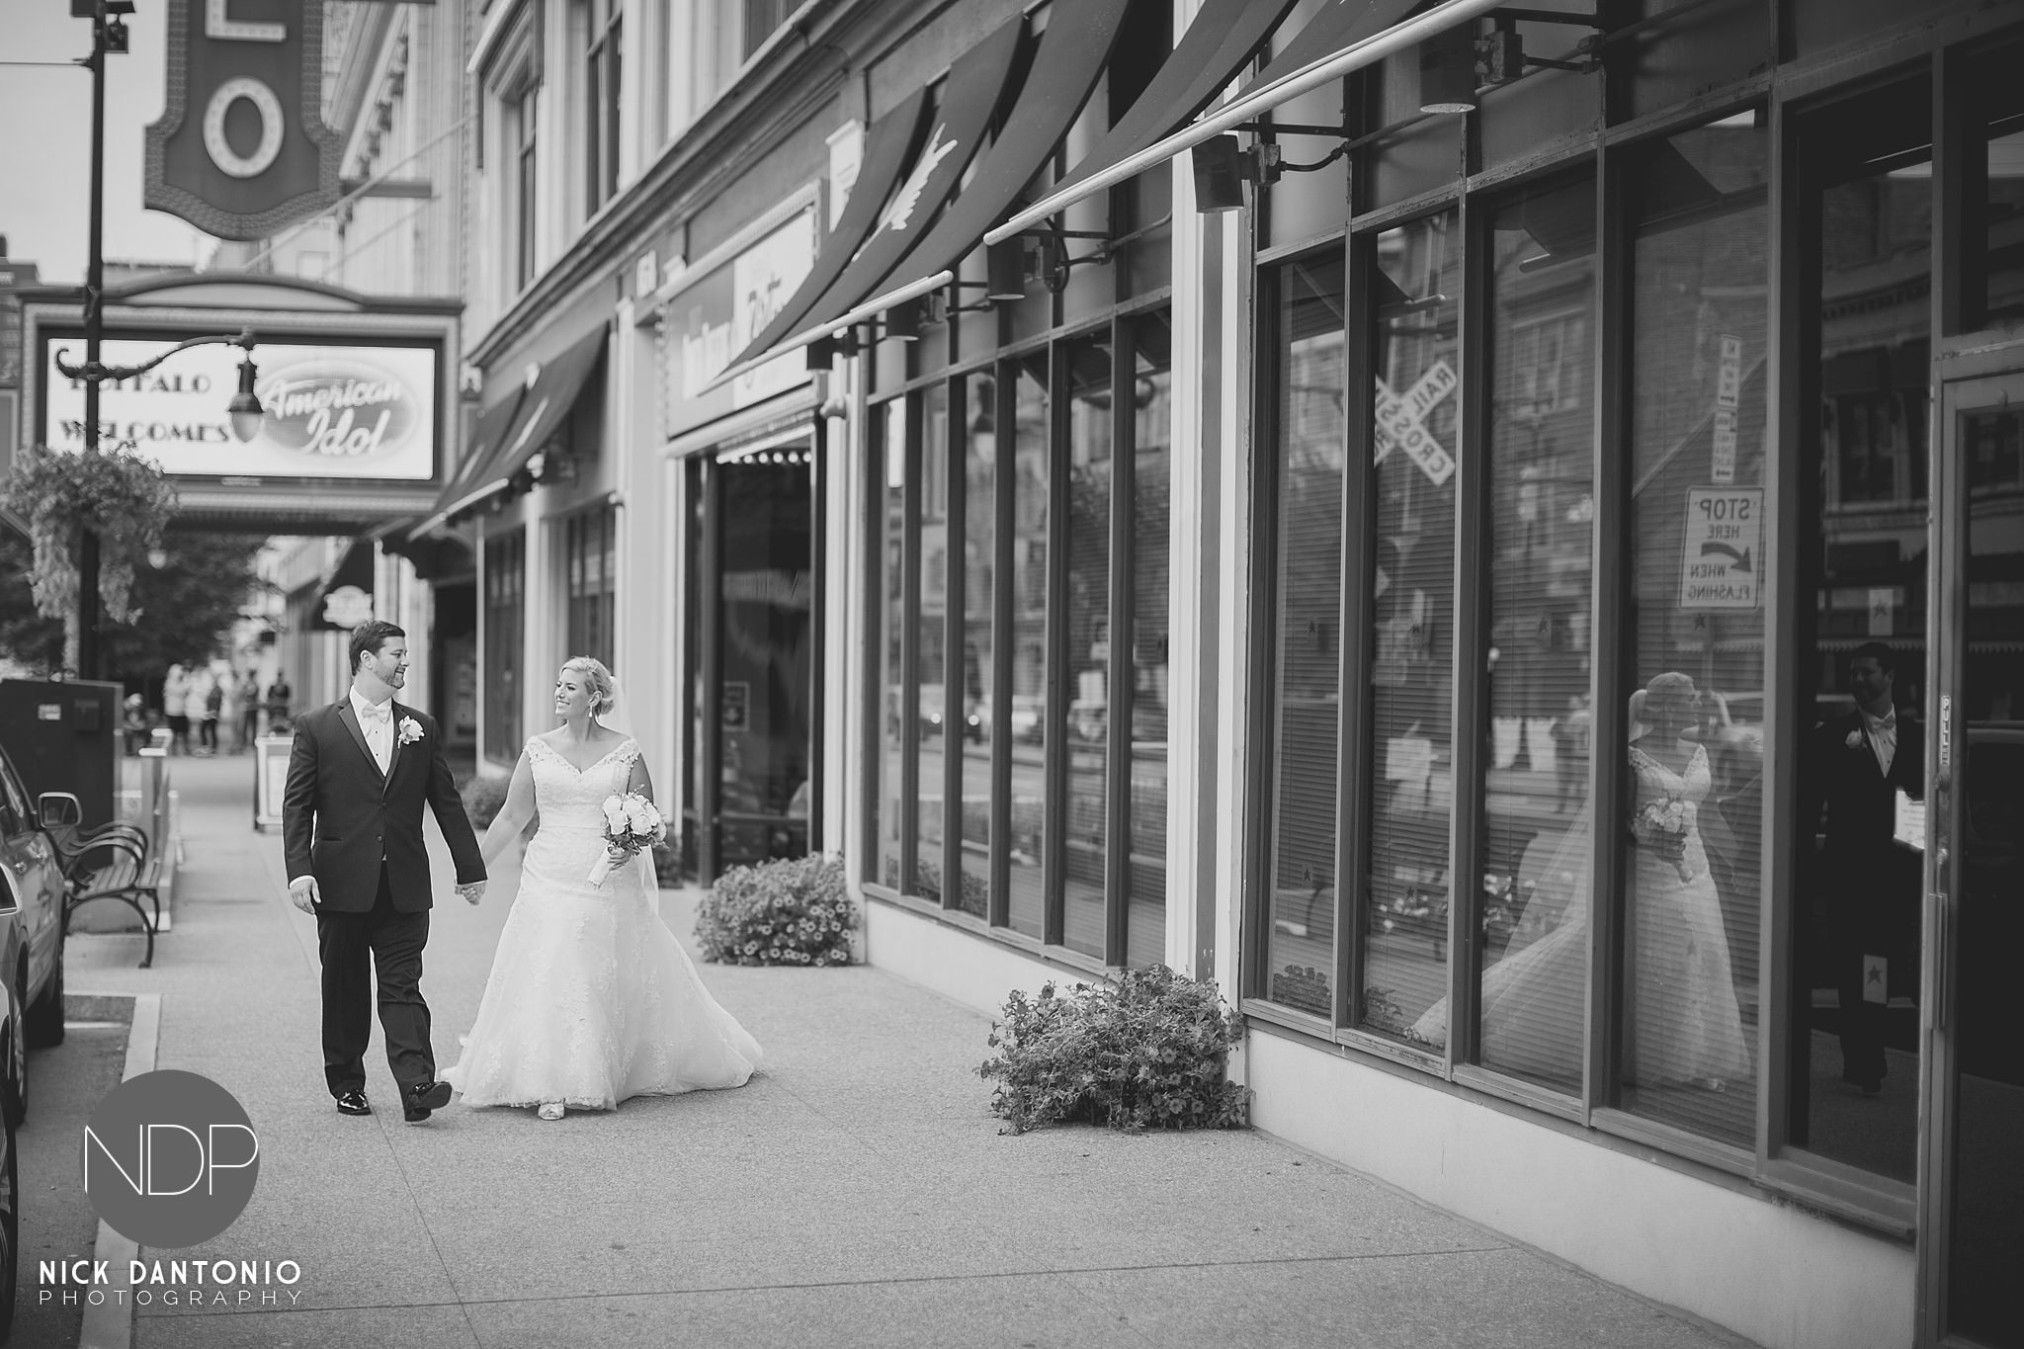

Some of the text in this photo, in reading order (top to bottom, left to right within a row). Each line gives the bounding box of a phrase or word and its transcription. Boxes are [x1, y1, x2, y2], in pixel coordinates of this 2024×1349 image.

[70, 374, 212, 392] FFALO
[261, 378, 401, 420] American
[59, 420, 230, 442] WLCOMES
[301, 407, 392, 455] Idol
[1942, 697, 1950, 746] PULL
